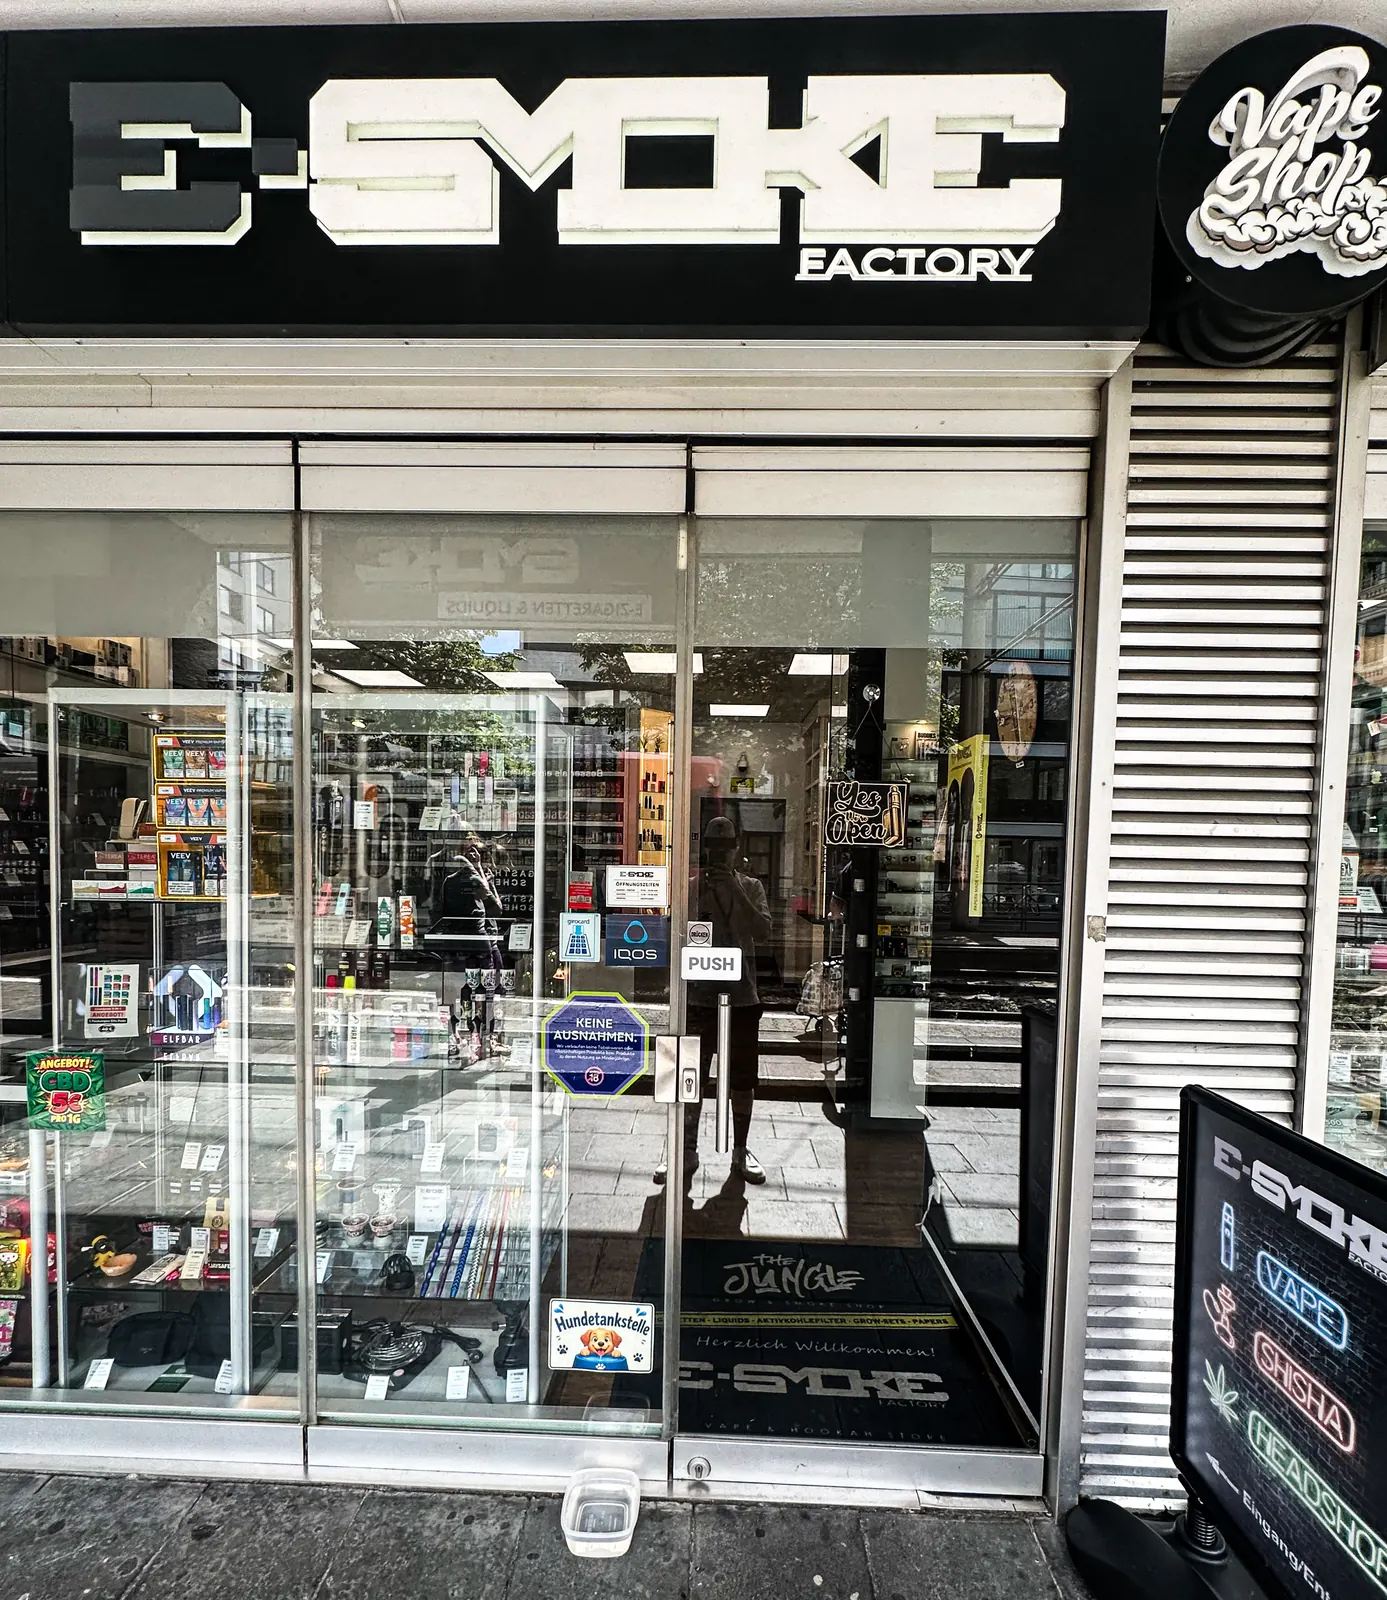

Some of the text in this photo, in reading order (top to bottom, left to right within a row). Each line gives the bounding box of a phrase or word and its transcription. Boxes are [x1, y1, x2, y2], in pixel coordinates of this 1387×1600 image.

[1208, 45, 1382, 162] Vape
[70, 74, 1066, 246] E-SMOKE
[1200, 135, 1371, 222] Shop
[795, 247, 1034, 281] FACTORY
[834, 781, 882, 818] Yes
[825, 812, 888, 845] Open
[567, 918, 590, 926] girocard
[613, 948, 658, 961] IQOS
[688, 956, 735, 971] PUSH
[576, 1017, 613, 1029] KEINE
[163, 1034, 201, 1044] ELFBAR
[553, 1029, 638, 1043] AUSNAHMEN.
[40, 1057, 91, 1069] ANGEBOT!
[42, 1071, 89, 1092] CBD
[51, 1091, 82, 1113] 5€
[51, 1113, 81, 1124] PRO 1G
[753, 1253, 798, 1266] THE
[723, 1259, 865, 1299] JUNGLE
[1264, 1256, 1337, 1338] VAPE
[554, 1309, 651, 1336] Hundetankstelle
[712, 1317, 750, 1325] LIQUIDS
[756, 1317, 847, 1325] AKTIVKOHLEFILTER
[912, 1318, 949, 1326] PAPERS
[696, 1335, 936, 1358] Herzlich Willkommen!
[678, 1360, 950, 1402] E-SMOKE
[1261, 1338, 1345, 1442] SHISHA
[878, 1399, 948, 1409] FACTORY
[790, 1426, 873, 1437] HOOKAH
